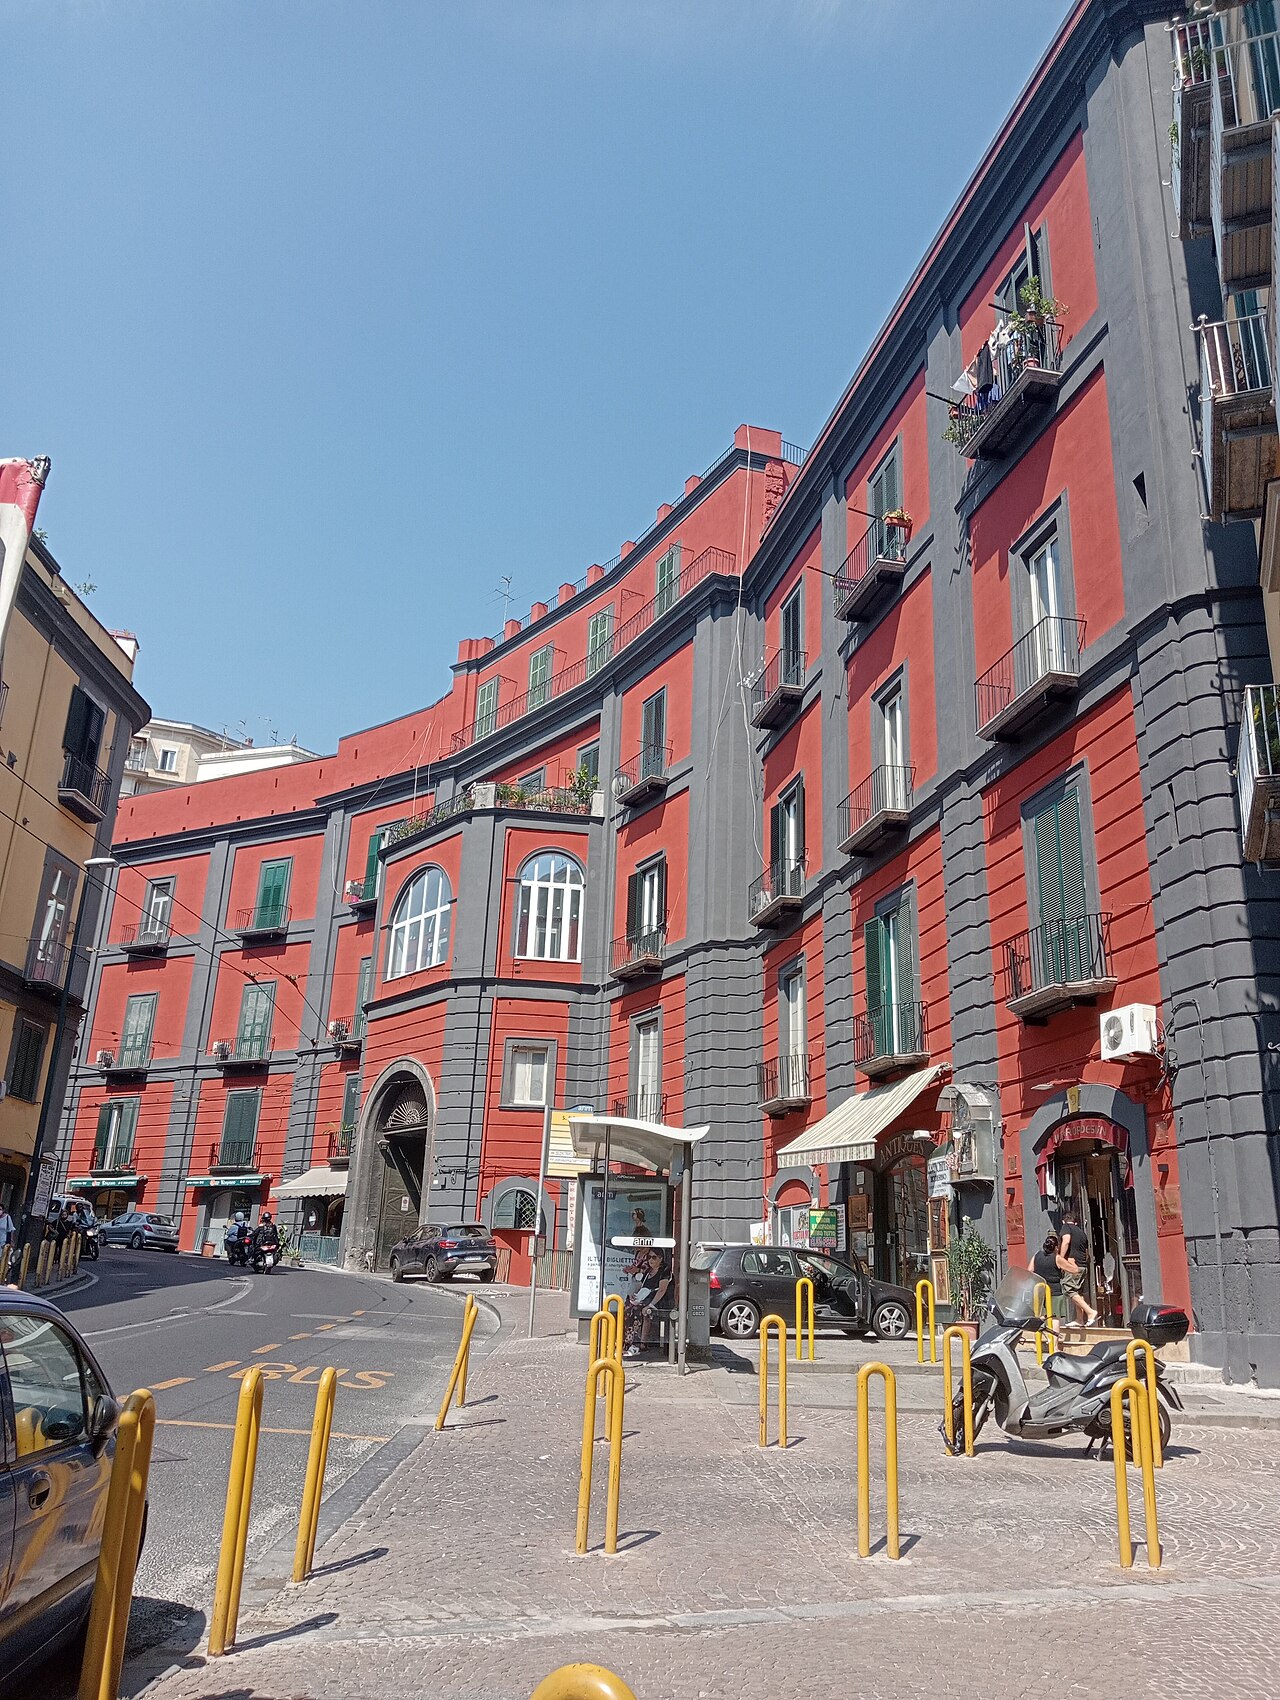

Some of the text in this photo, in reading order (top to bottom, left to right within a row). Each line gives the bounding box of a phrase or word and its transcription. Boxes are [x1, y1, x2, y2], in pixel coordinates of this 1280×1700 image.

[879, 1136, 925, 1167] ANTIQUES
[633, 1237, 654, 1246] anm
[228, 1362, 395, 1389] BUS
